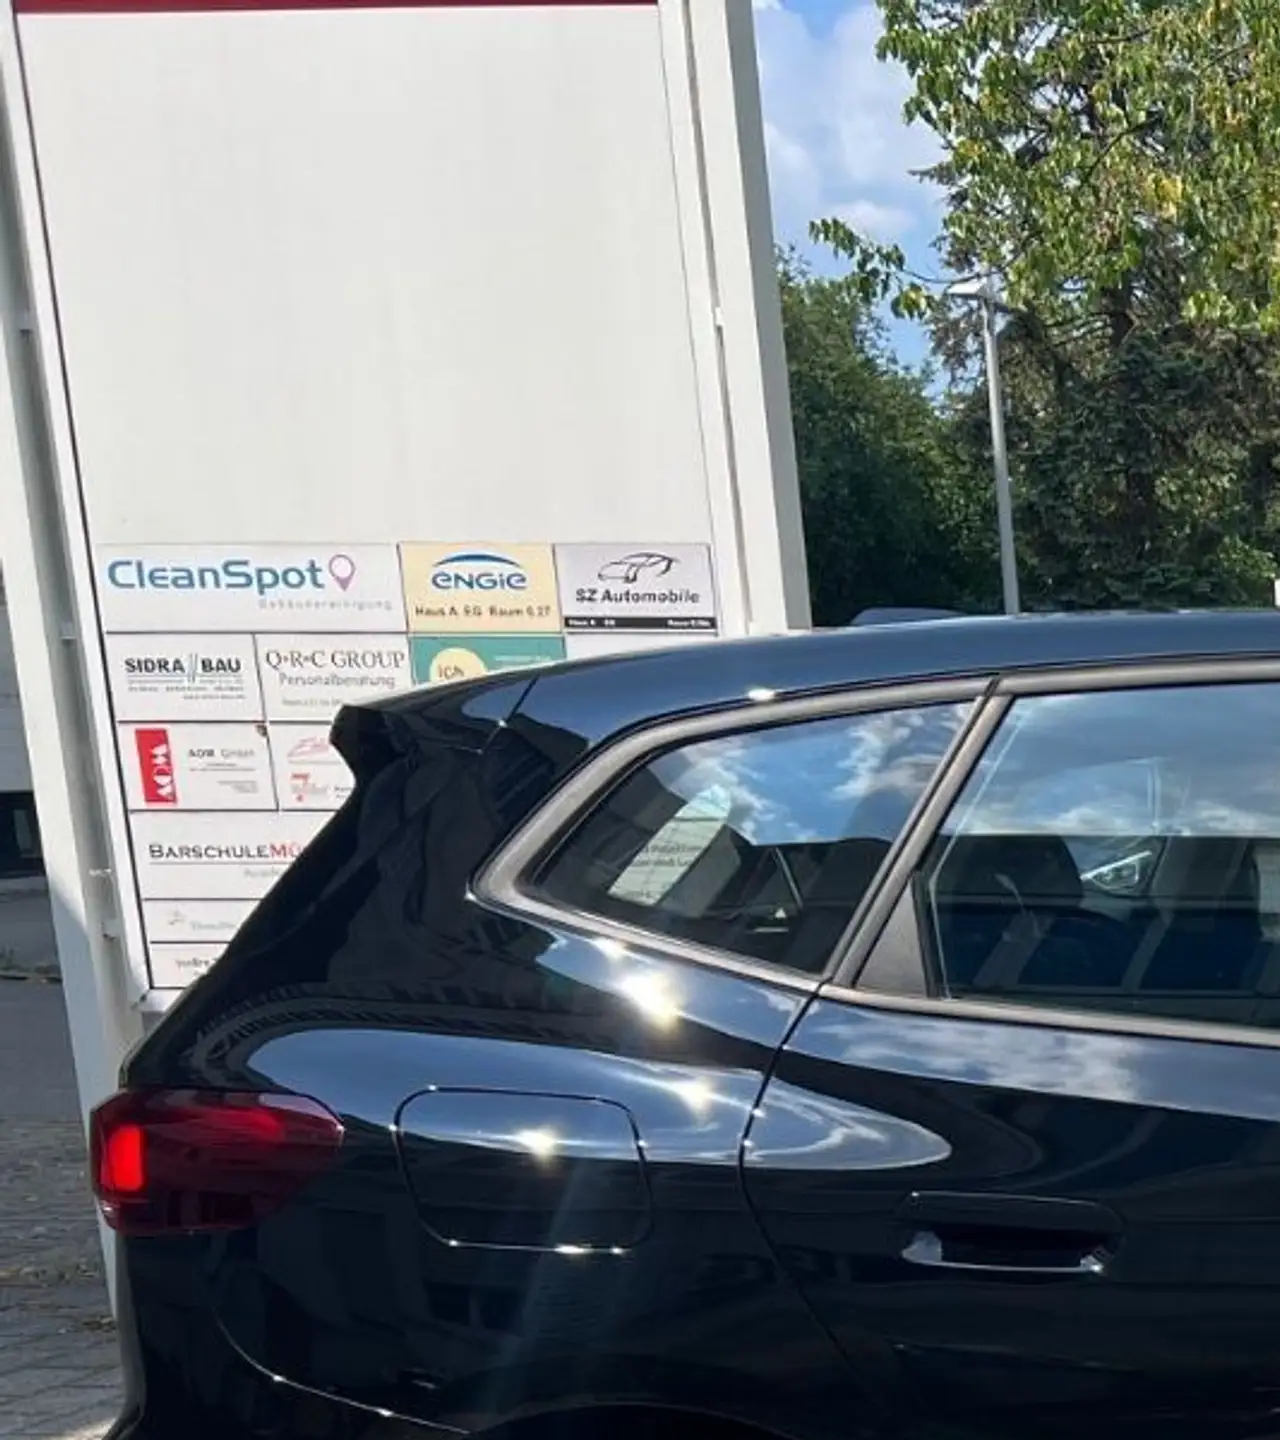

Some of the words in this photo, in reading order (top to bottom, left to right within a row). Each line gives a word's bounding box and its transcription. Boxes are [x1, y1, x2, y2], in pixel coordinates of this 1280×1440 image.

[108, 559, 325, 595] CleanSpot
[575, 588, 598, 603] SZ
[600, 588, 701, 604] Automobile
[125, 658, 185, 673] SIDRA
[201, 657, 242, 673] BAU
[331, 650, 405, 668] GROUP
